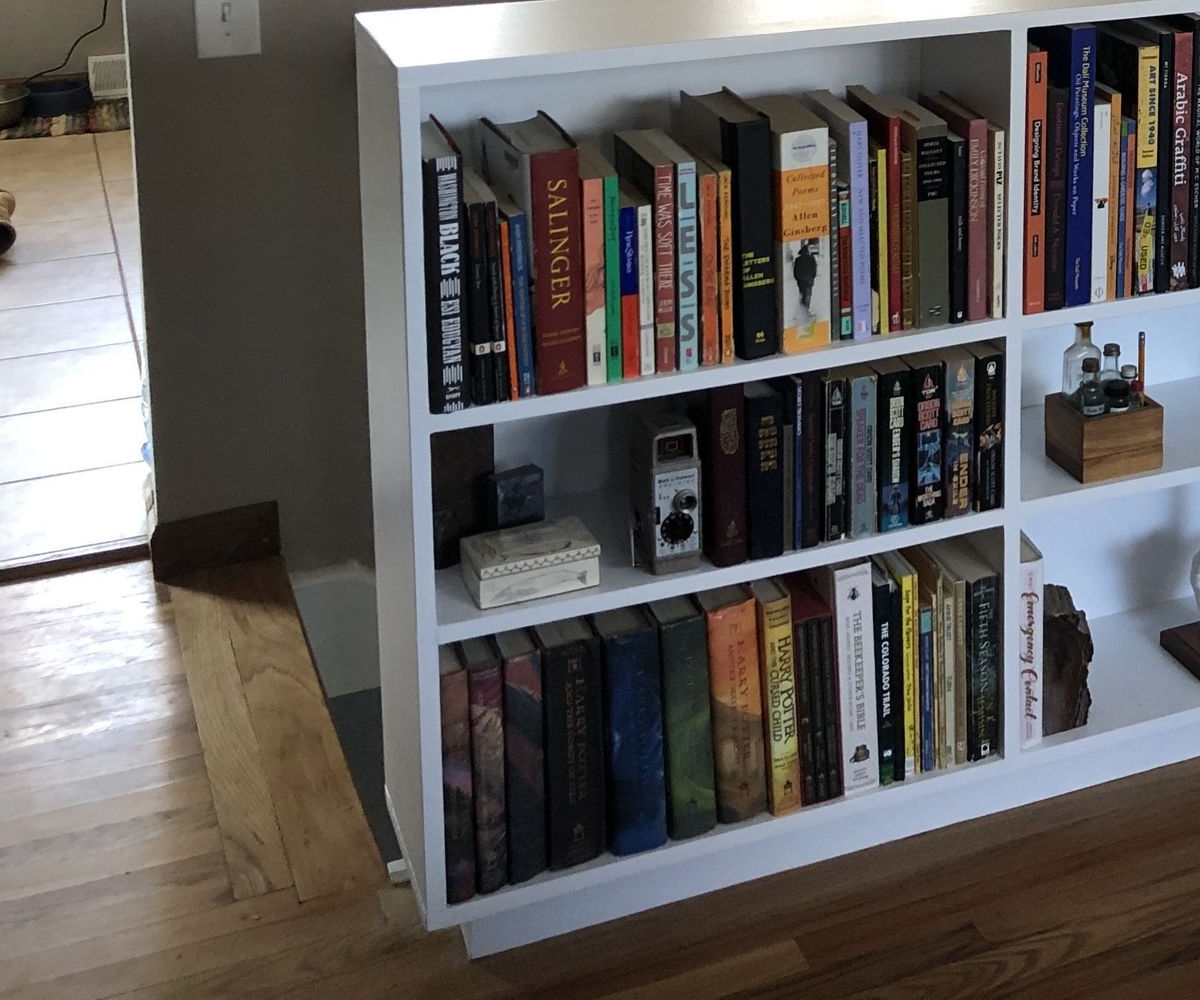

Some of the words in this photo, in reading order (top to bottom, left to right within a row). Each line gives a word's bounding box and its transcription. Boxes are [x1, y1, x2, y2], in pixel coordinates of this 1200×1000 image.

[1081, 46, 1090, 61] The
[1074, 73, 1082, 84] Oil
[1148, 65, 1157, 85] ART
[1080, 80, 1089, 115] Museum
[1147, 88, 1156, 117] SINCE
[1175, 72, 1188, 123] Arabic
[1032, 121, 1041, 158] Designing
[1072, 122, 1080, 148] Objects
[1079, 117, 1088, 157] Collection
[1147, 120, 1156, 145] 1940
[969, 139, 979, 167] EMILY
[1173, 127, 1188, 186] Graffiti
[1194, 153, 1200, 164] OF
[785, 170, 825, 184] Collected
[1032, 160, 1041, 182] Brand
[1071, 163, 1079, 184] Works
[437, 172, 459, 221] WASHINGTON
[656, 174, 672, 199] TIME
[791, 186, 819, 197] Poems
[969, 168, 979, 223] DICKINSON
[1031, 183, 1041, 213] Identity
[1071, 185, 1078, 195] on
[656, 202, 673, 229] WAS
[792, 212, 818, 222] Allen
[1069, 196, 1078, 216] Paper
[547, 178, 571, 310] SALINGER
[657, 231, 673, 256] SOFT
[783, 225, 827, 238] Ginsberg
[438, 222, 461, 276] BLACK
[1139, 245, 1149, 270] USED
[657, 262, 674, 290] THERE
[440, 299, 461, 316] ESI
[441, 317, 462, 364] EDUGYAN
[917, 398, 940, 411] ORSON
[918, 408, 940, 421] SCOTT
[856, 407, 865, 447] SPEAKER
[919, 418, 939, 431] CARD
[856, 449, 865, 463] FOR
[891, 428, 901, 458] ENDER'S
[856, 464, 865, 479] THE
[958, 452, 969, 509] ENDER
[852, 611, 863, 632] THE
[880, 621, 889, 640] THE
[977, 602, 990, 639] FIFTH
[1019, 591, 1040, 664] Emergency
[778, 634, 792, 683] HARRY
[853, 635, 865, 701] BEEKEEPER'S
[880, 640, 890, 690] COLORADO
[978, 641, 991, 693] SEASON
[769, 670, 781, 708] CURSED
[1020, 668, 1039, 720] Contact
[780, 686, 796, 744] POTTER
[855, 702, 867, 731] BIBLE
[882, 691, 891, 718] TRAIL
[772, 710, 782, 742] CHILD
